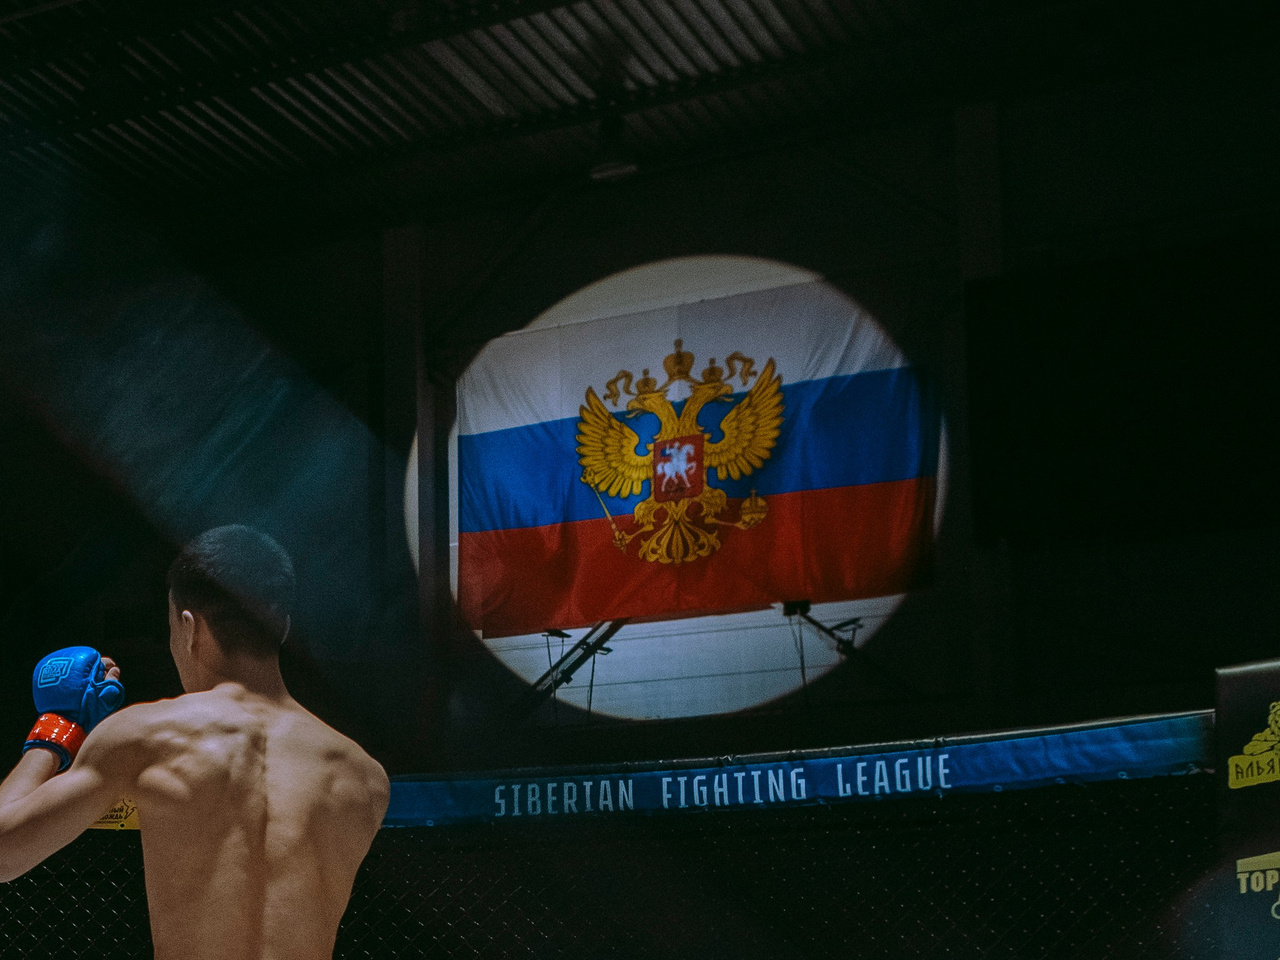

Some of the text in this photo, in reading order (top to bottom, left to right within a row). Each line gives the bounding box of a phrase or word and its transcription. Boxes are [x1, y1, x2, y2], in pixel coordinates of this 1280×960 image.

[494, 754, 952, 817] SIBERIAN FIGHTING LEAGUE
[1234, 757, 1280, 780] АЛЬЯ
